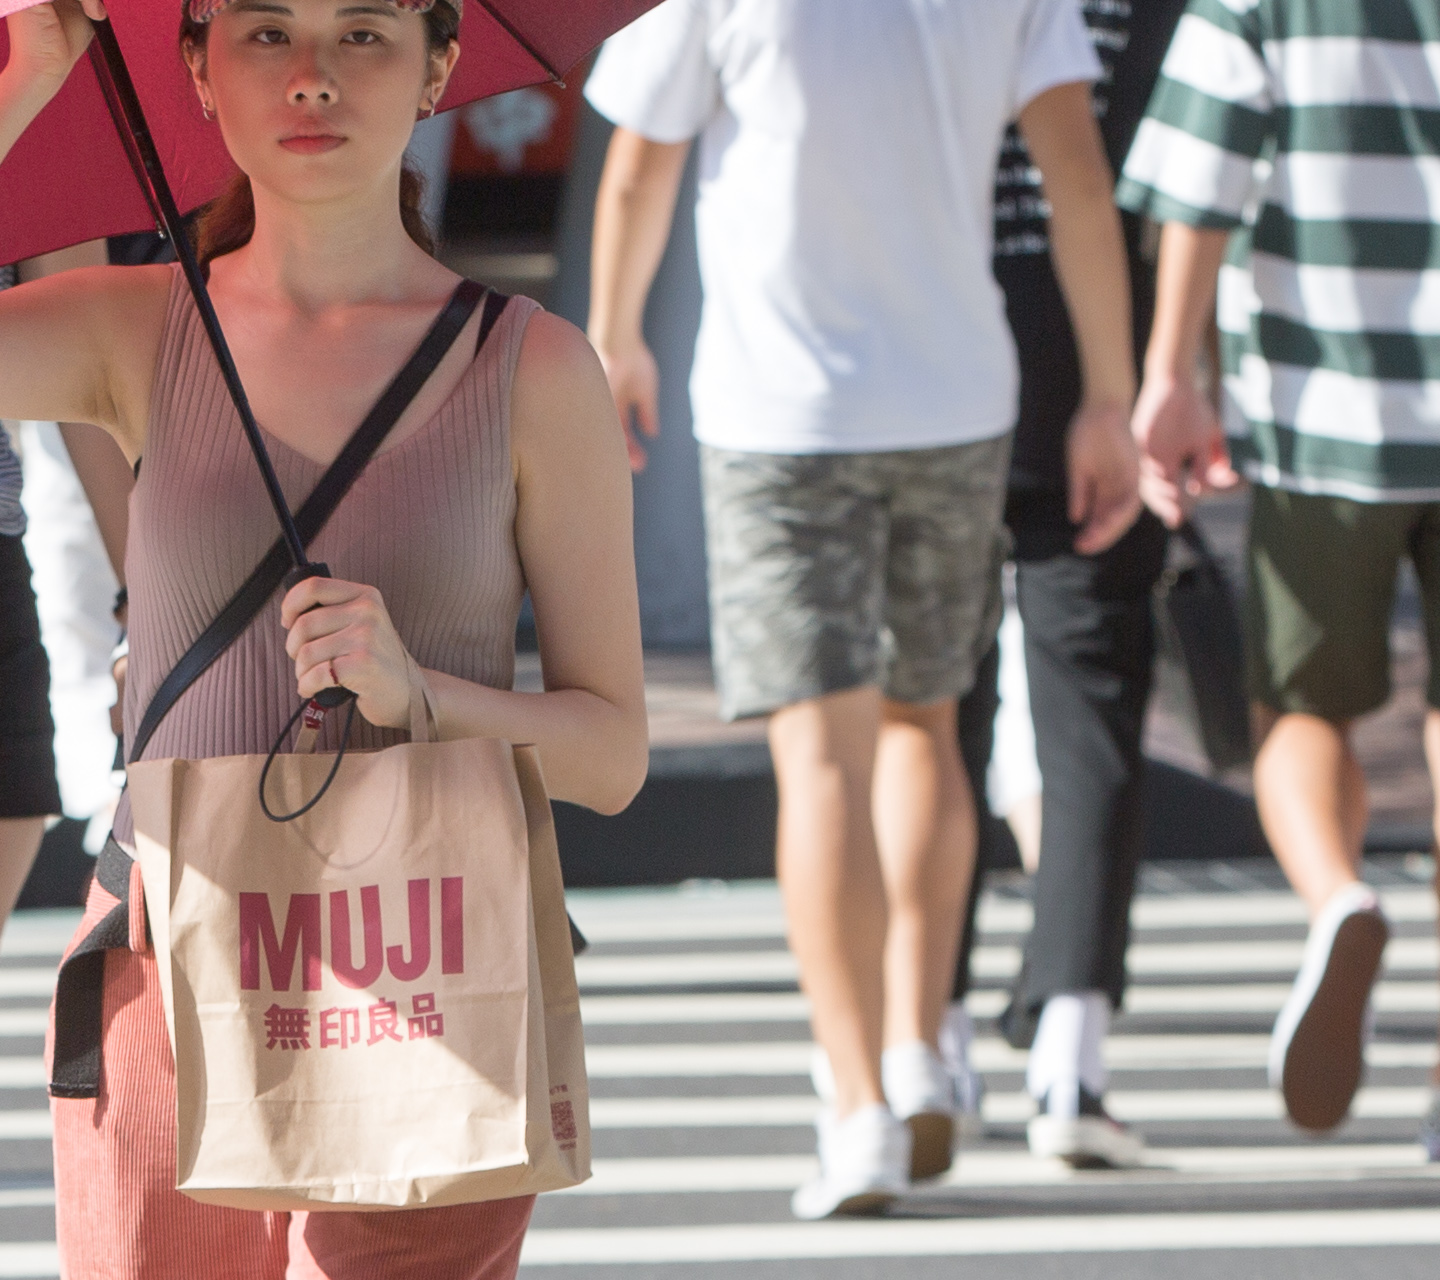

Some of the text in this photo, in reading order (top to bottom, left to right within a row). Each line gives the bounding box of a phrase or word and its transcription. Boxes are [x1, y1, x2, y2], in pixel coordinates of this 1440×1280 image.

[239, 876, 464, 992] MUJI
[264, 992, 445, 1051] 無印良品
